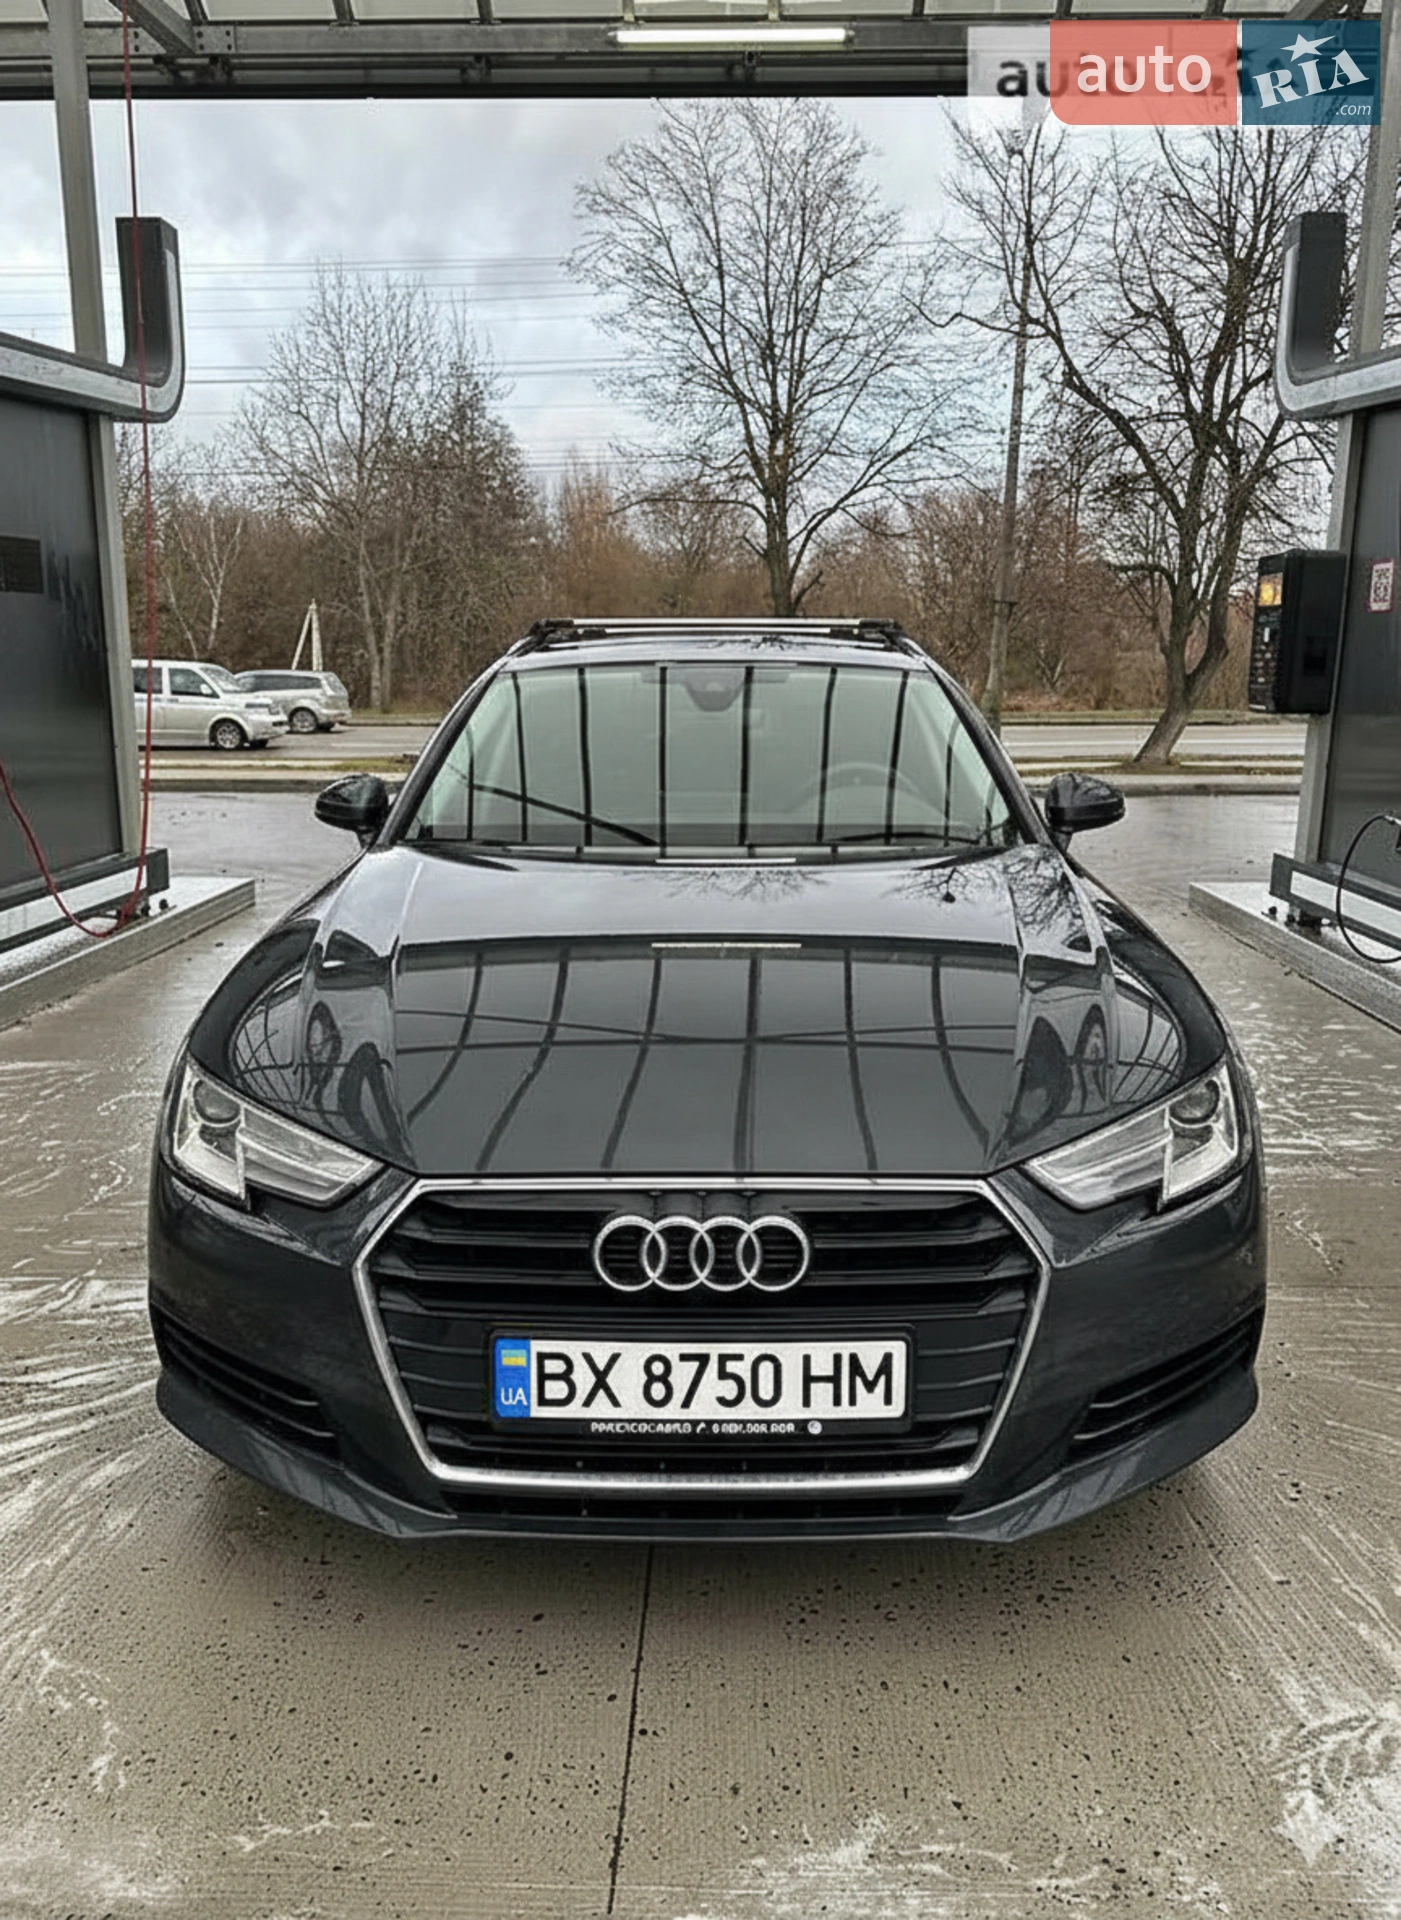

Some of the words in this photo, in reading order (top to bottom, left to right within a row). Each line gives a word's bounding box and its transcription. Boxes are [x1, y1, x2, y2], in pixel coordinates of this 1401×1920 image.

[501, 1388, 528, 1405] UA
[536, 1352, 621, 1408] BX
[643, 1353, 782, 1408] 8750
[802, 1351, 892, 1408] HM
